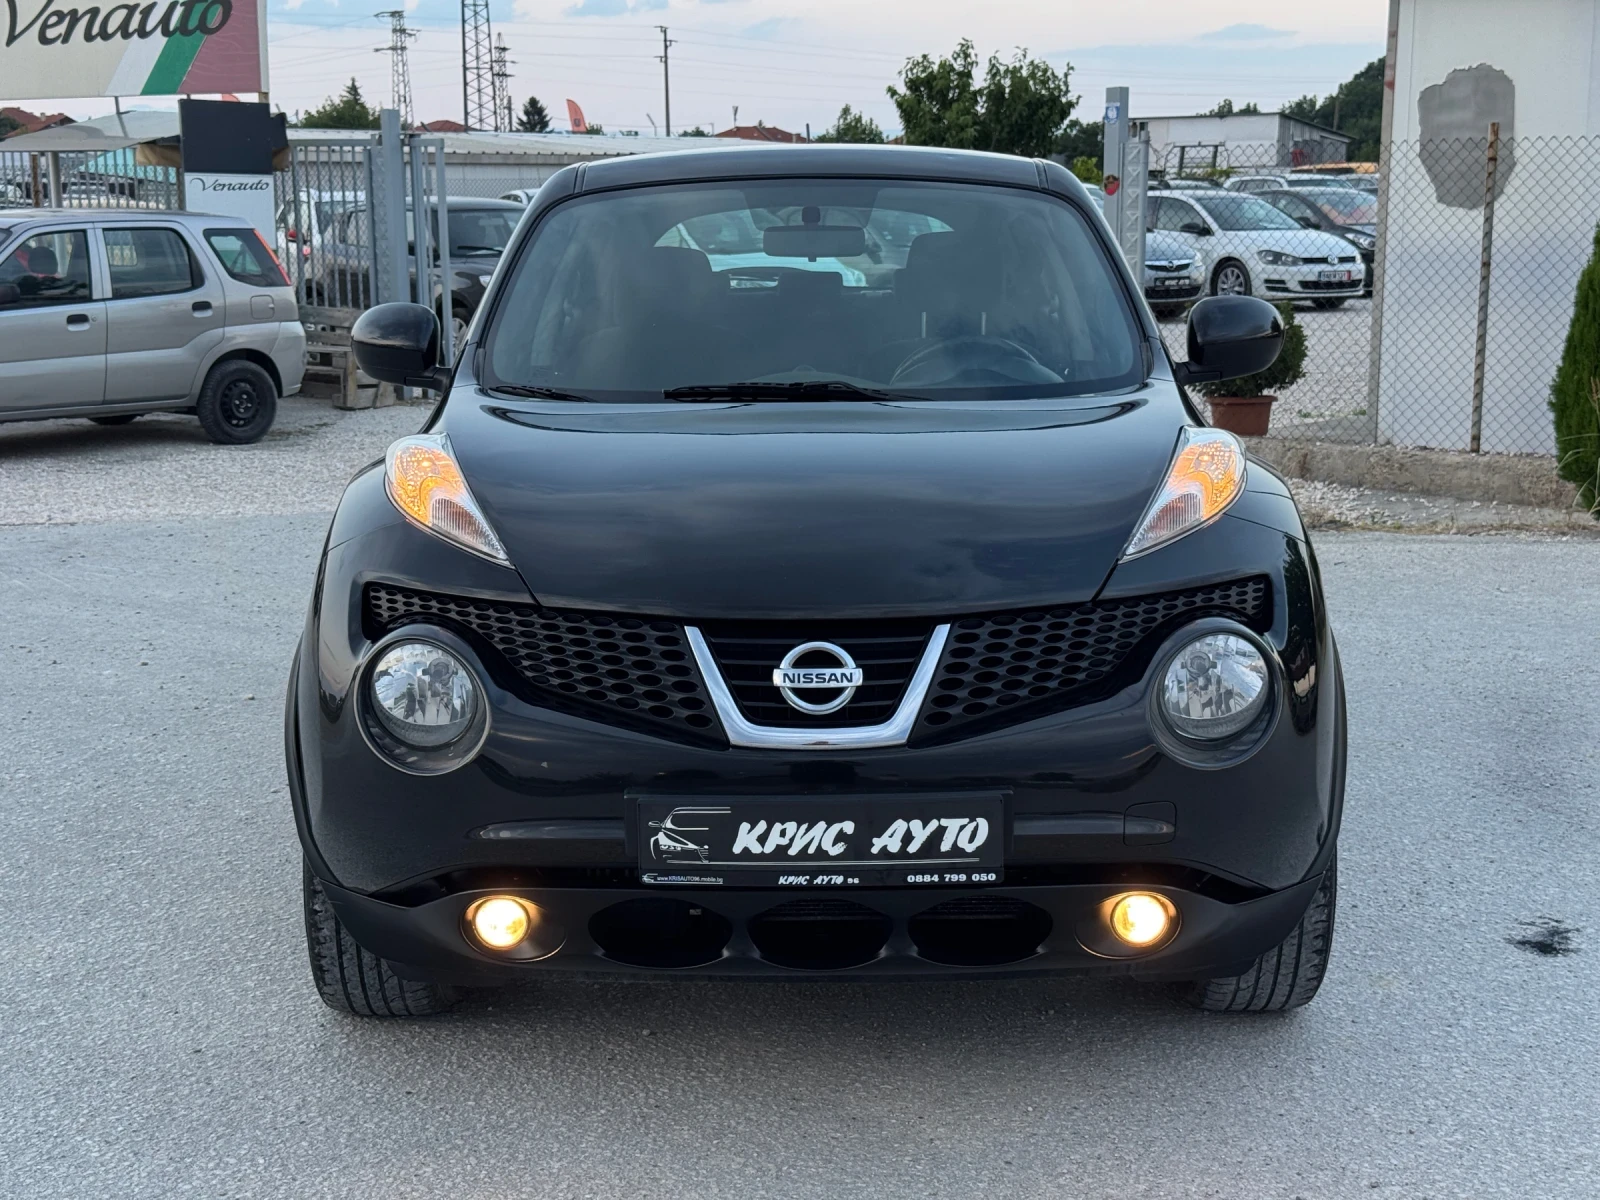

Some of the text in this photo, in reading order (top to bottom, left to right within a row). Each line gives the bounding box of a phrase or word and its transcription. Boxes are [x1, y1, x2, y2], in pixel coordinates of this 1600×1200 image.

[4, 0, 233, 47] Venauto
[189, 177, 270, 191] Venauto
[782, 672, 854, 684] NISSAN
[732, 817, 989, 856] КРИС АУТО
[778, 875, 810, 884] КРИС
[813, 875, 844, 884] АУТО
[907, 873, 996, 883] 0884 799 050
